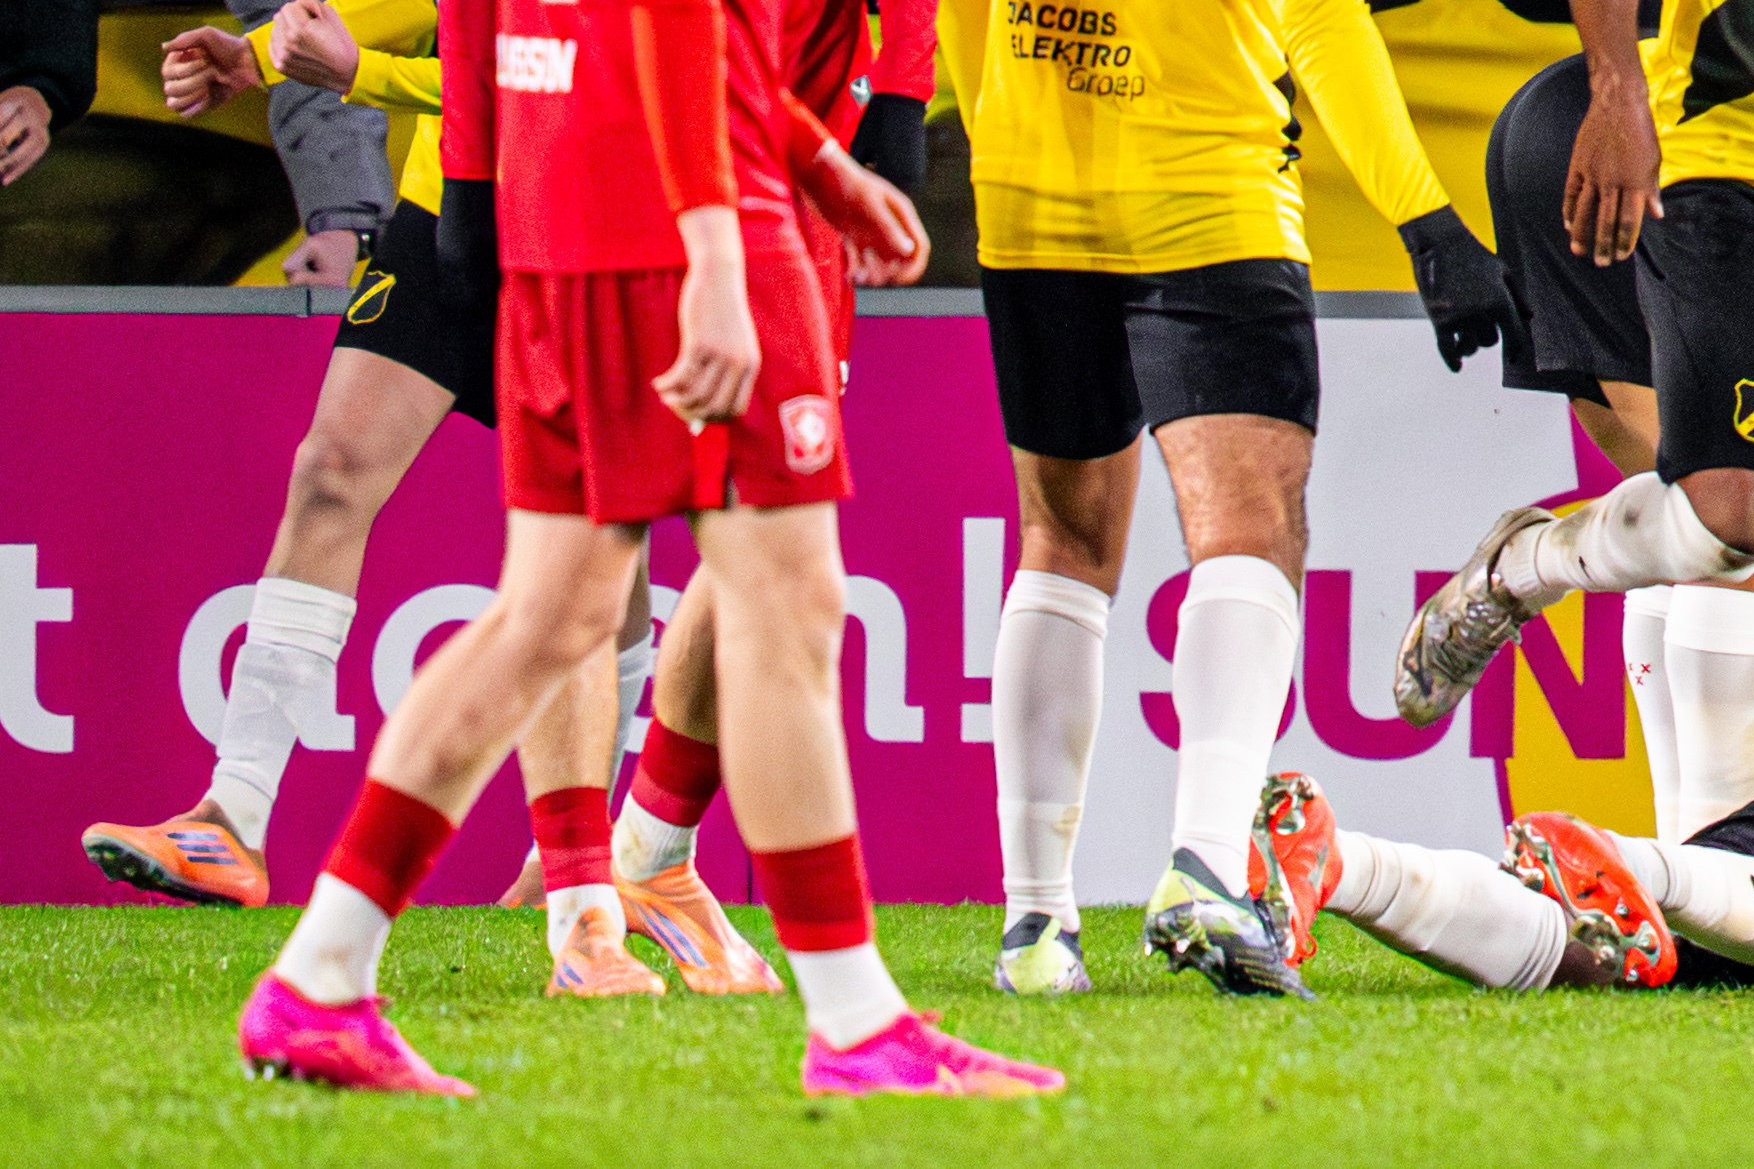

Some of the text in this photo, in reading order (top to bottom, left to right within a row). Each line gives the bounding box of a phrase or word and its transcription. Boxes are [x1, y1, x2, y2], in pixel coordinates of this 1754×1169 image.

[1008, 0, 1118, 37] JACOBS
[1011, 33, 1132, 68] ELEKTRO
[1066, 66, 1146, 102] Groep
